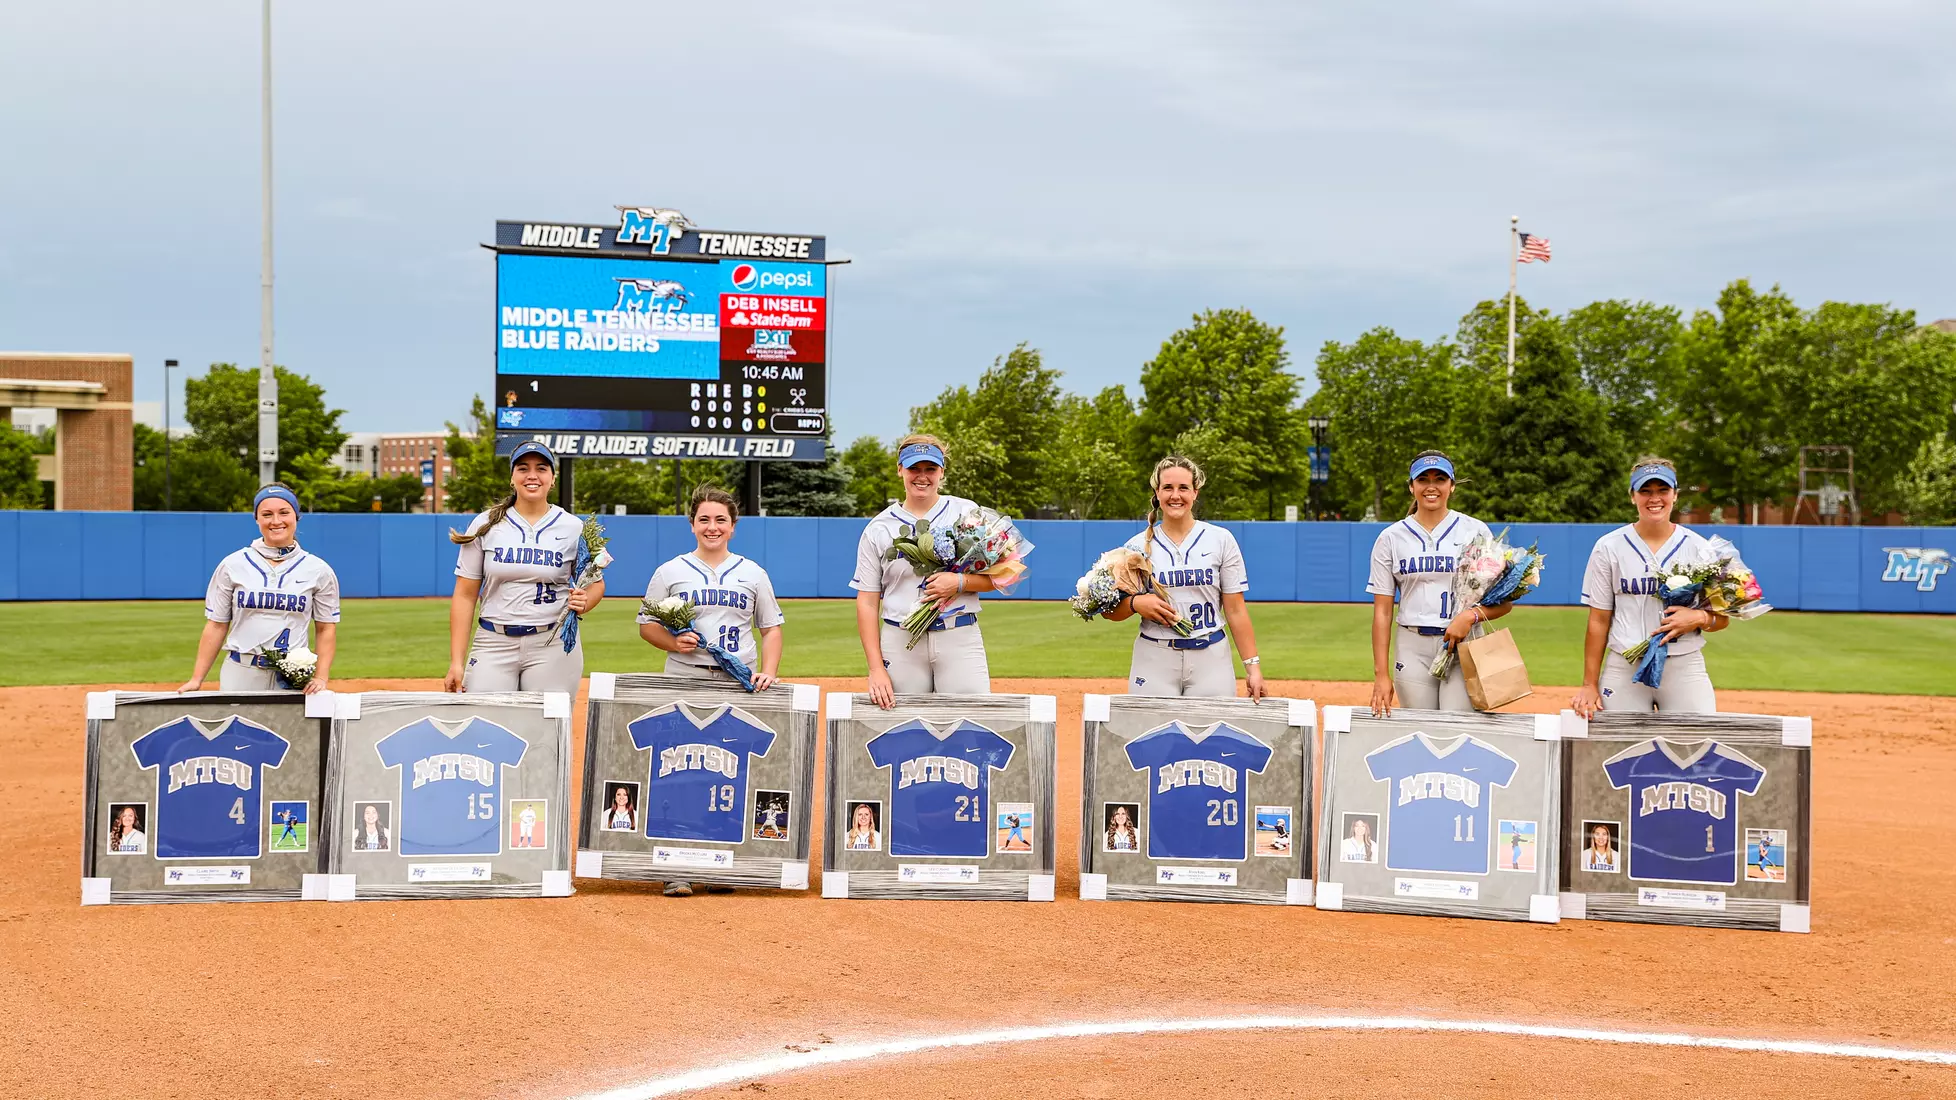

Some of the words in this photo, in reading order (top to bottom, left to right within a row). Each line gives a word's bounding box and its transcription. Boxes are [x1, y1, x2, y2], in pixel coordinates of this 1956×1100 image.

[520, 224, 603, 250] MIDDLE
[698, 232, 813, 258] TENNESSEE
[760, 271, 814, 289] pepsi
[727, 297, 760, 311] DEB
[763, 298, 817, 313] INSELL
[501, 306, 587, 328] MIDDLE
[592, 309, 717, 333] TENNESSEE
[501, 329, 560, 350] BLUE
[564, 331, 660, 353] RAIDERS
[754, 329, 793, 345] EXIT
[529, 380, 539, 392] 1
[742, 366, 779, 379] 10:45
[781, 367, 804, 380] AM
[690, 383, 701, 397] R
[707, 384, 717, 398] H
[723, 384, 732, 398] E
[742, 384, 753, 398] B
[757, 386, 766, 397] 0
[691, 400, 700, 411] 0
[707, 400, 717, 412] 0
[723, 400, 732, 412] 0
[743, 401, 752, 415] S
[757, 402, 766, 413] 0
[691, 416, 700, 428] 0
[707, 417, 717, 429] 0
[723, 417, 732, 429] 0
[757, 419, 766, 429] 0
[798, 419, 820, 428] MPH
[582, 436, 648, 456] RAIDER
[652, 438, 741, 457] SOFTBALL
[744, 440, 795, 458] FIELD
[492, 547, 564, 568] RAIDERS
[1399, 556, 1455, 575] RAIDER
[237, 591, 307, 613] RAIDERS
[533, 582, 558, 605] 15
[1189, 601, 1217, 630] 20
[274, 627, 291, 652] 4
[719, 625, 740, 652] 19
[412, 753, 494, 790] MTSU
[659, 743, 739, 779] MTSU
[898, 755, 979, 790] MTSU
[168, 756, 253, 794] MTSU
[1157, 759, 1238, 795] MTSU
[708, 784, 736, 812] 19
[1398, 772, 1480, 808] MTSU
[1640, 781, 1726, 820] MTSU
[228, 797, 245, 825] 4
[467, 793, 494, 820] 15
[954, 795, 981, 822] 21
[1206, 799, 1239, 826] 20
[1453, 815, 1475, 842] 11
[1704, 824, 1715, 853] 1
